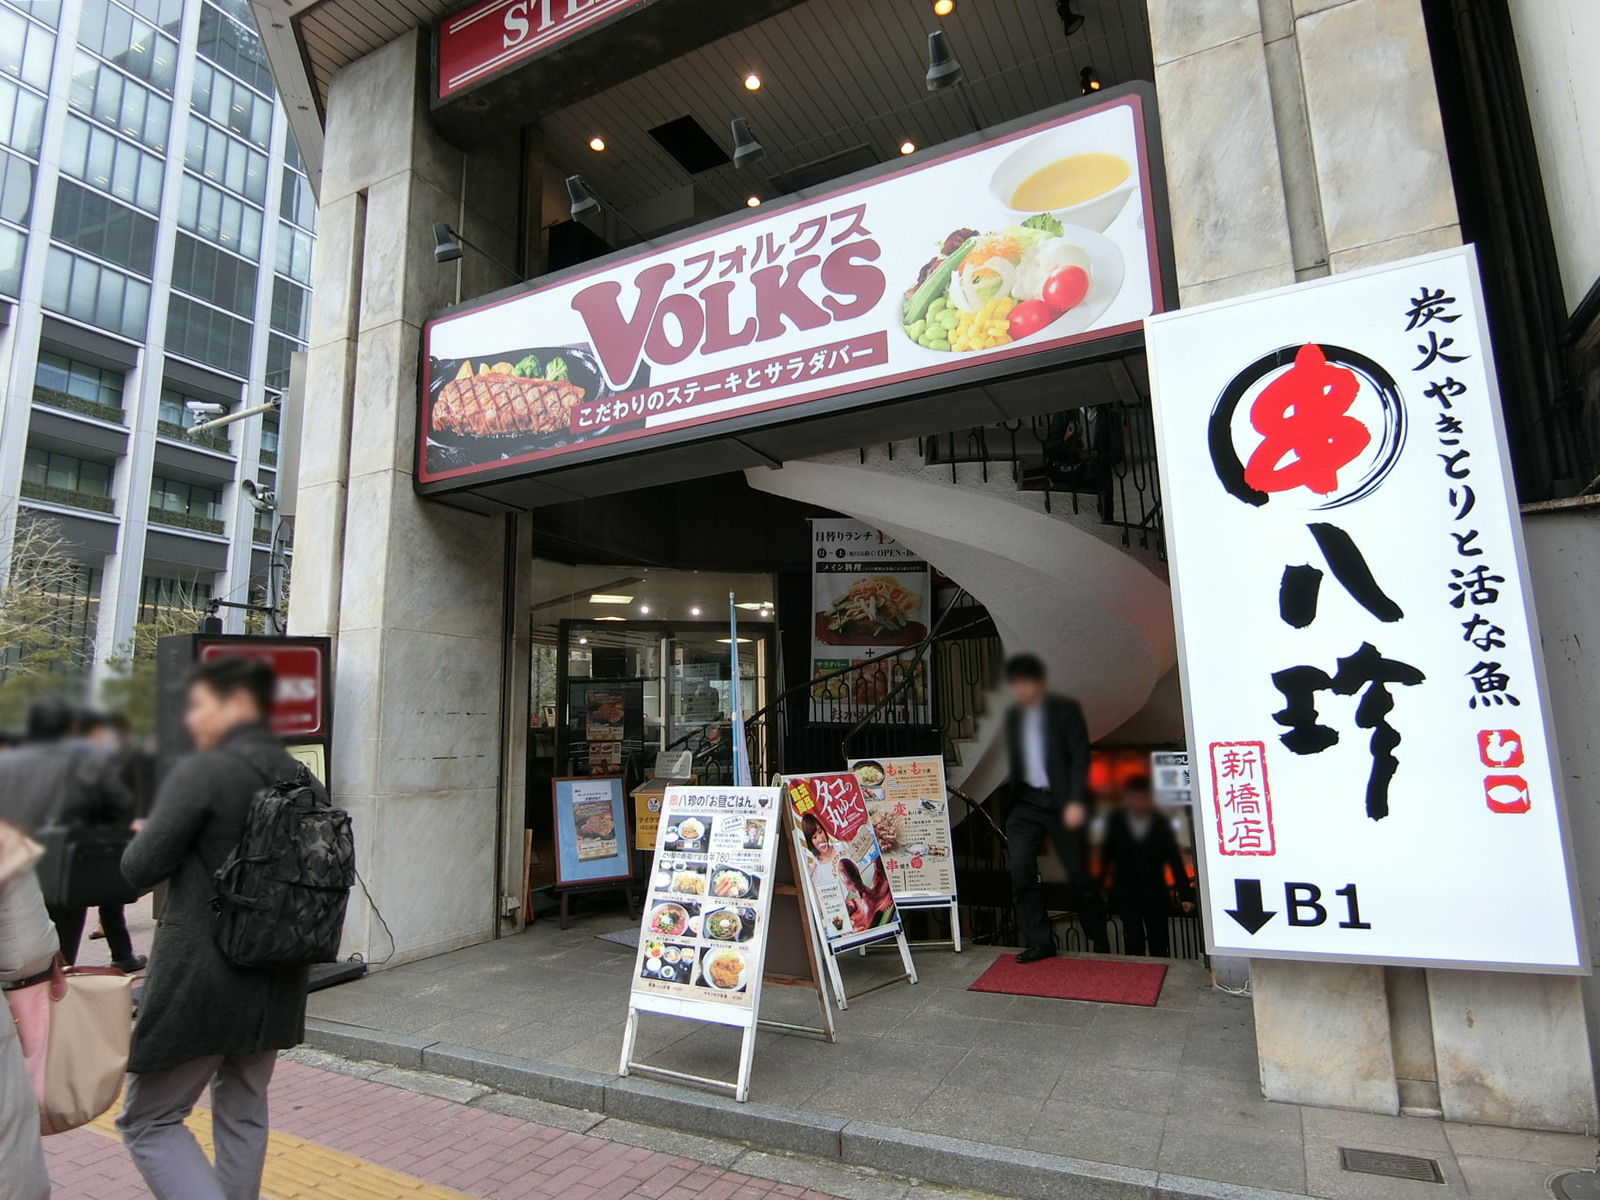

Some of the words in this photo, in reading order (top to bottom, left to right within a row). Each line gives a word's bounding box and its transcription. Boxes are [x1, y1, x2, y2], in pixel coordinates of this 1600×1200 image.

[682, 203, 868, 289] フォルクス
[571, 236, 888, 391] VOLKS
[578, 345, 874, 427] こだわりのステーキとサラダバー
[1404, 286, 1521, 709] 炭火やきとりと活な魚
[815, 531, 872, 542] 日替りランチ
[822, 563, 863, 572] メイン料理
[814, 778, 853, 816] タコの
[826, 792, 865, 836] 丸ゆで
[1220, 750, 1265, 850] 新橋店
[1284, 882, 1372, 930] B1
